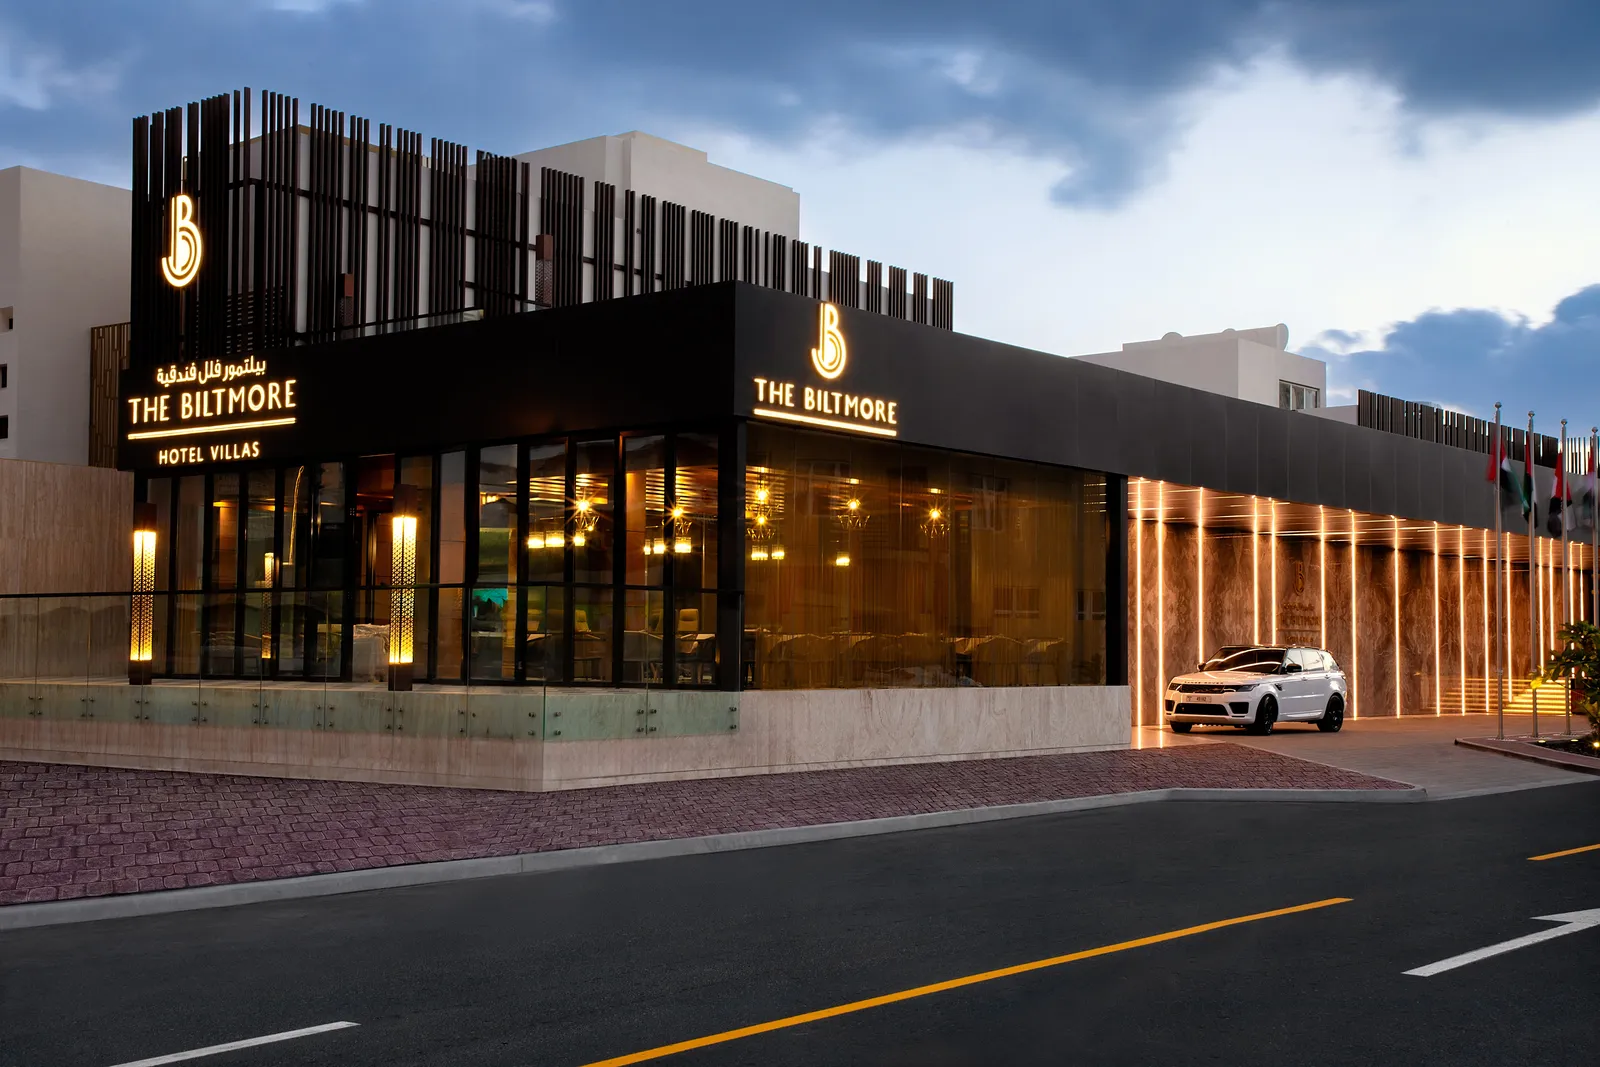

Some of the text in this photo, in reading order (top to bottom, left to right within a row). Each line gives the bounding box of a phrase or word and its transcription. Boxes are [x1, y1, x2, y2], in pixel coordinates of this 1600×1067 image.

[156, 355, 266, 387] بيلتمور فلل فندقية
[128, 379, 297, 424] THE BILTMORE
[754, 378, 897, 424] THE BILTMORE
[158, 441, 260, 465] HOTEL VILLAS
